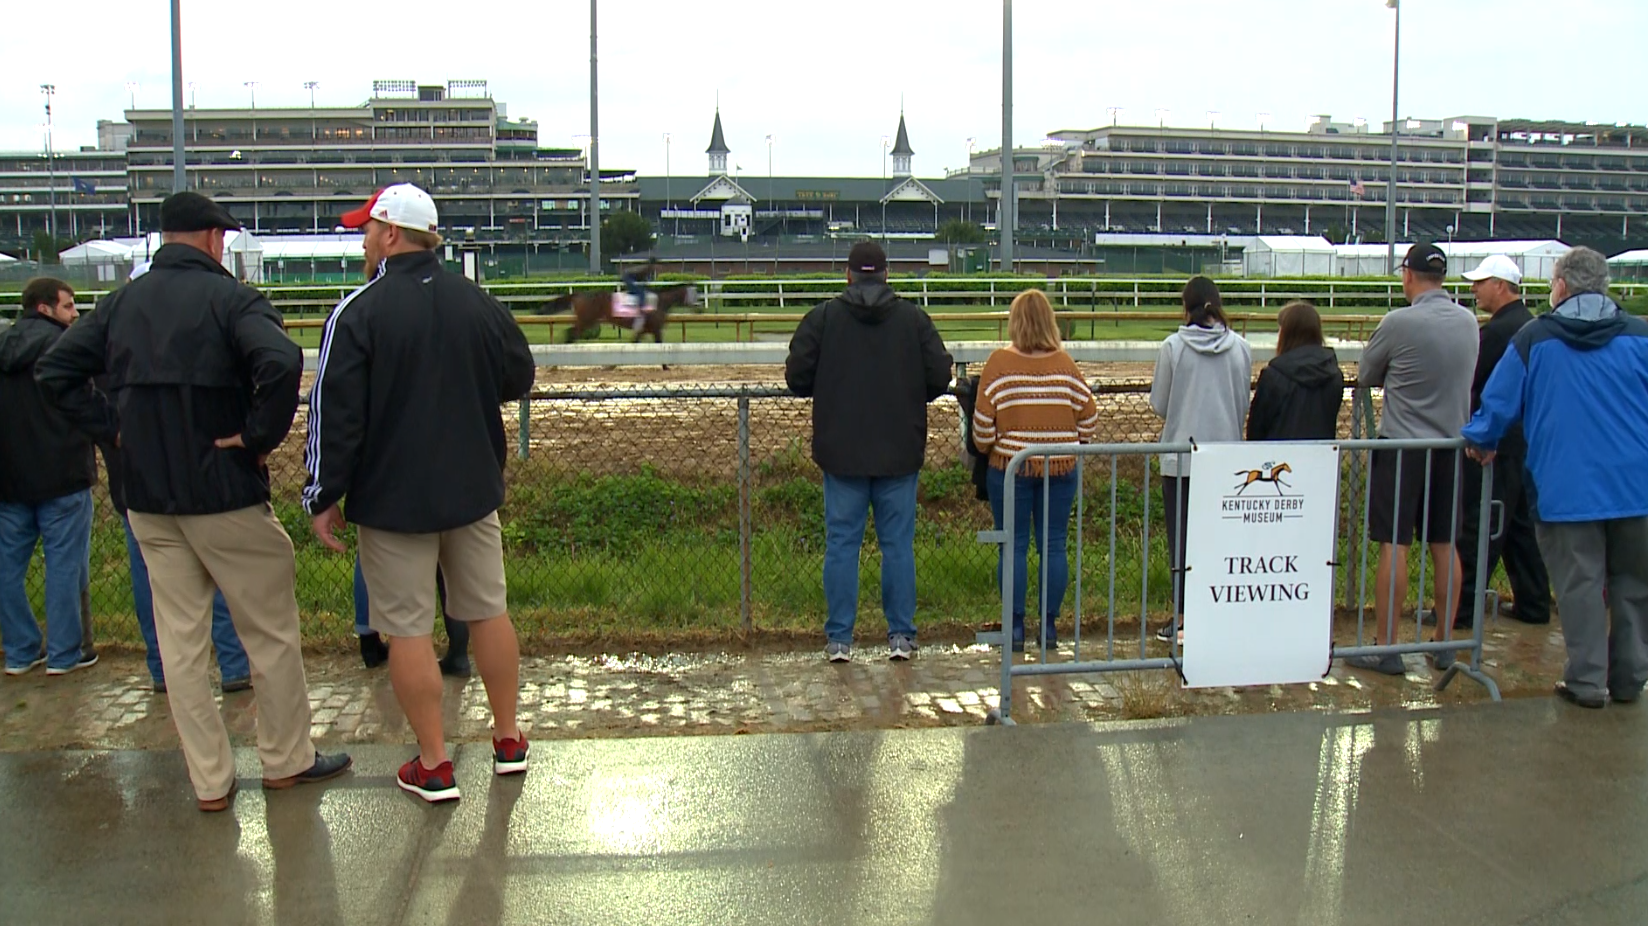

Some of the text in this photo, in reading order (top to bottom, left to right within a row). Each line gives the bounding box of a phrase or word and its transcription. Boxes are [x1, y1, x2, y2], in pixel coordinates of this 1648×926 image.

[1222, 498, 1304, 511] KENTUCKY DERBY
[1243, 512, 1283, 523] MUSEUM
[1224, 555, 1298, 574] TRACK
[1209, 583, 1309, 603] VIEWING
